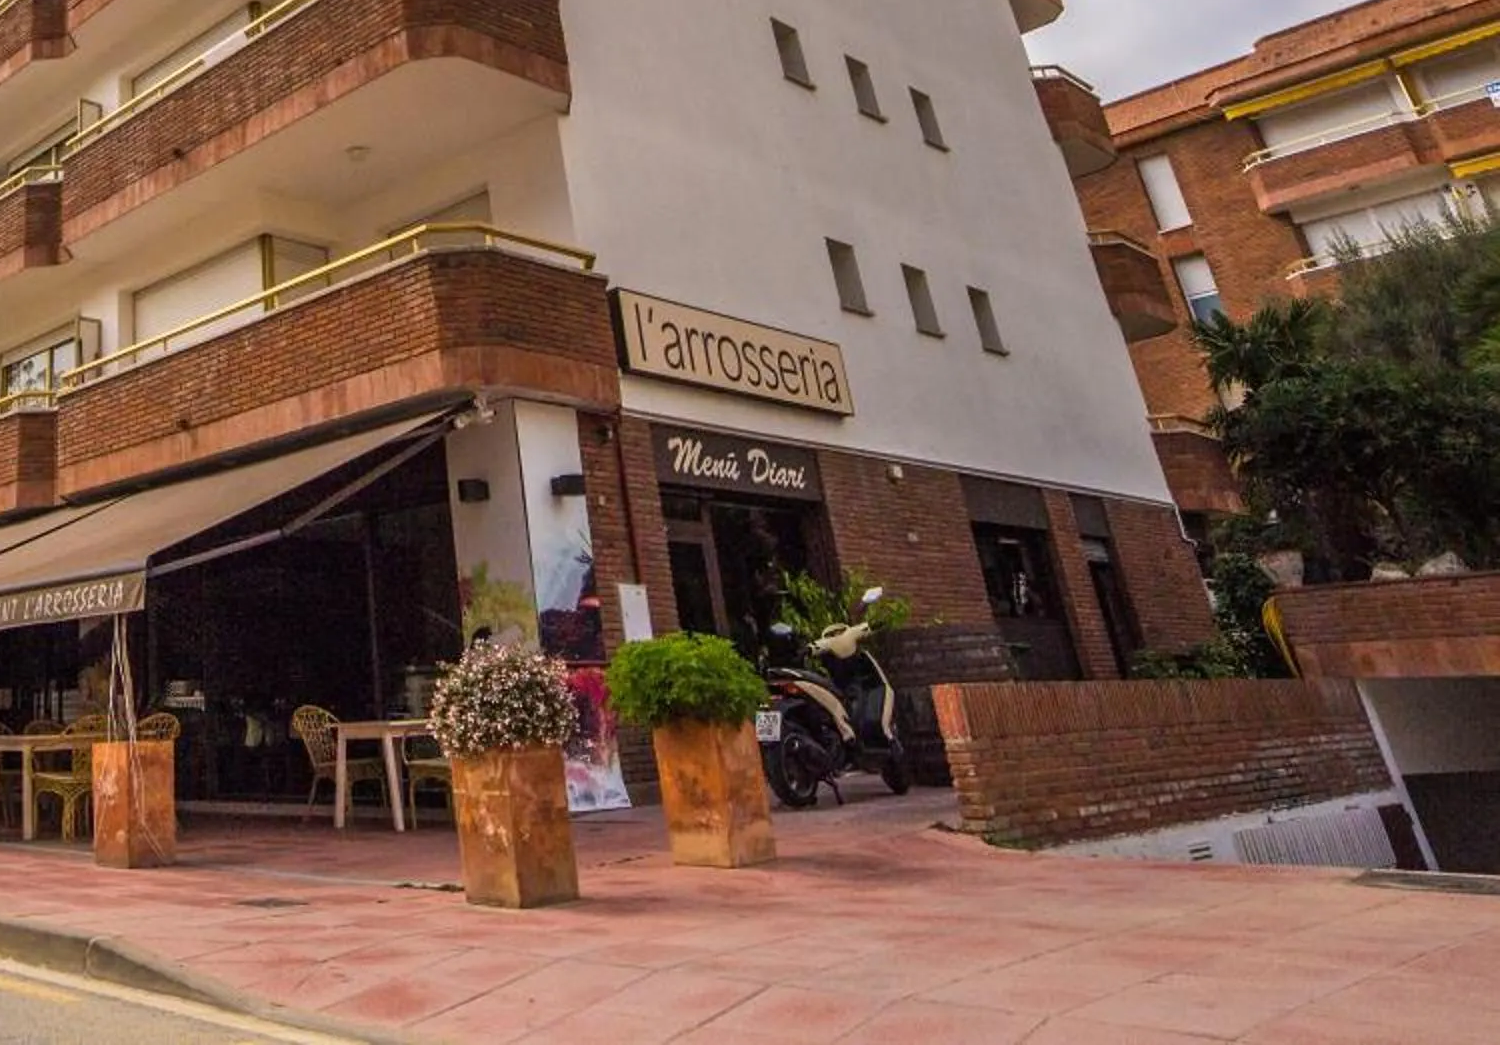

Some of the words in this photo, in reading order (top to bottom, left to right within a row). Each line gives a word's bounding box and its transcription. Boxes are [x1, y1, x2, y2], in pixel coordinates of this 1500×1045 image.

[634, 303, 843, 404] l'arrosseria
[667, 436, 741, 481] Menú
[747, 448, 807, 490] Diari
[23, 580, 124, 621] L'ARROSSERIA
